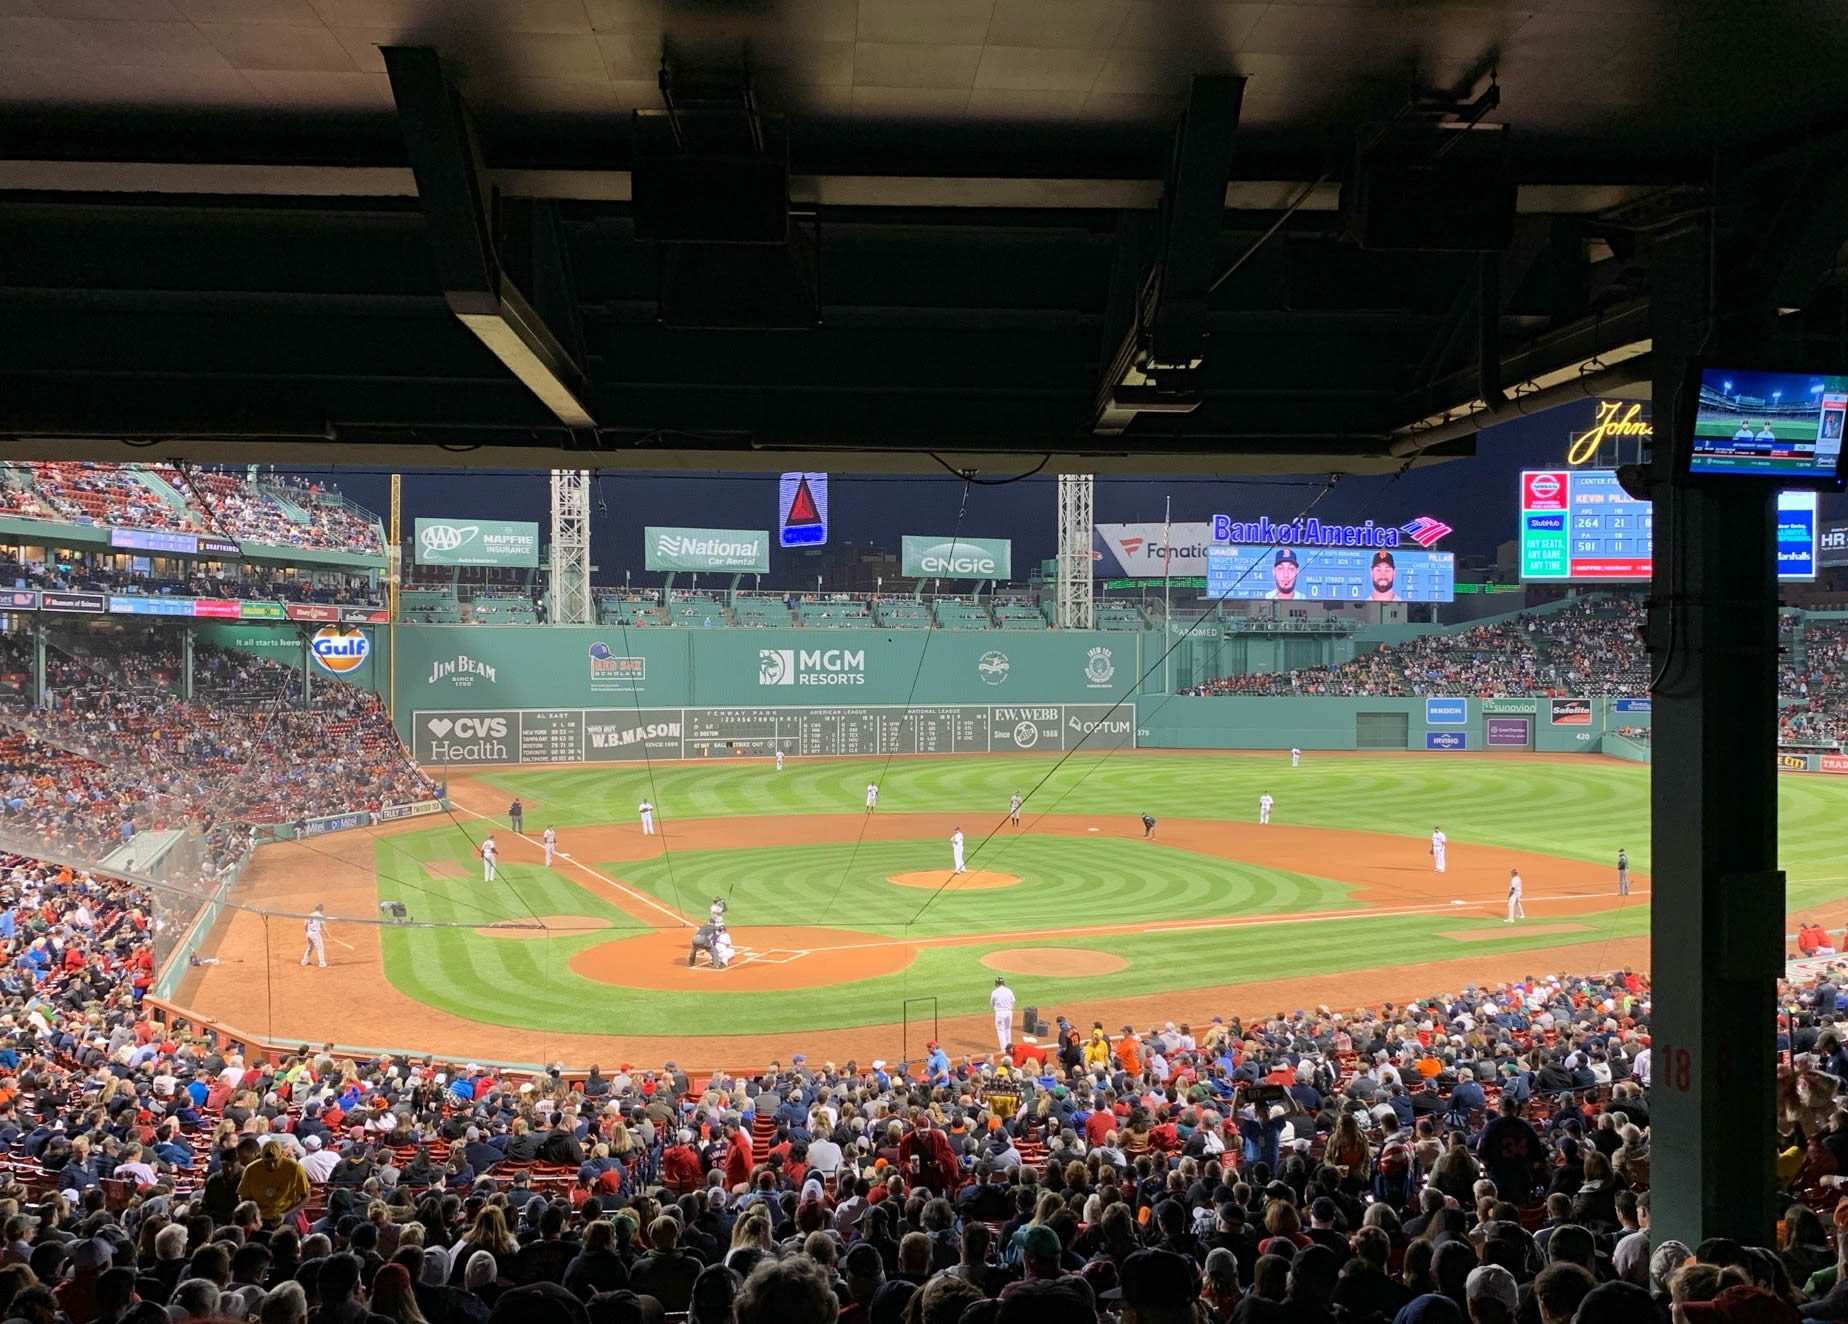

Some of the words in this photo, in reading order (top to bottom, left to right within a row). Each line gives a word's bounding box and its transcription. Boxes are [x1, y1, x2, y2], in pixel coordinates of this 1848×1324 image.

[1576, 495, 1604, 503] KEVIN
[1575, 519, 1599, 528] .264
[1614, 519, 1625, 528] 21
[1212, 514, 1276, 543] Bank
[1276, 517, 1304, 545] of
[1304, 517, 1400, 547] America
[426, 528, 455, 549] AAA
[484, 535, 533, 544] MAPFRE
[205, 544, 240, 553] DRAFTKINGS
[486, 545, 531, 553] INSURANCE
[681, 538, 758, 557] National
[1528, 540, 1540, 548] ANY
[1578, 542, 1595, 551] 581
[1615, 542, 1622, 551] 11
[1528, 550, 1540, 558] ANY
[1778, 552, 1811, 560] arshalls
[708, 557, 724, 566] Car
[726, 557, 755, 566] Rental
[1530, 562, 1544, 570] ANY
[1311, 586, 1318, 597] 0
[1351, 587, 1359, 597] 0
[279, 639, 300, 647] here
[313, 638, 366, 656] Gulf
[595, 660, 616, 670] RED
[620, 660, 641, 670] SOX
[799, 649, 865, 671] MGM
[428, 660, 456, 684] JIM
[458, 655, 496, 683] BEAM
[799, 674, 865, 685] RESORTS
[1494, 703, 1536, 711] sunovion
[1553, 706, 1590, 714] Safelite
[1018, 708, 1058, 720] WEBB
[454, 717, 508, 738] CVS
[587, 726, 602, 734] WHO
[604, 724, 616, 732] BUT
[1083, 721, 1130, 734] OPTUM
[994, 730, 1010, 738] Since
[430, 739, 508, 761] Health
[1784, 756, 1806, 769] CITY
[1662, 1044, 1691, 1093] 18
